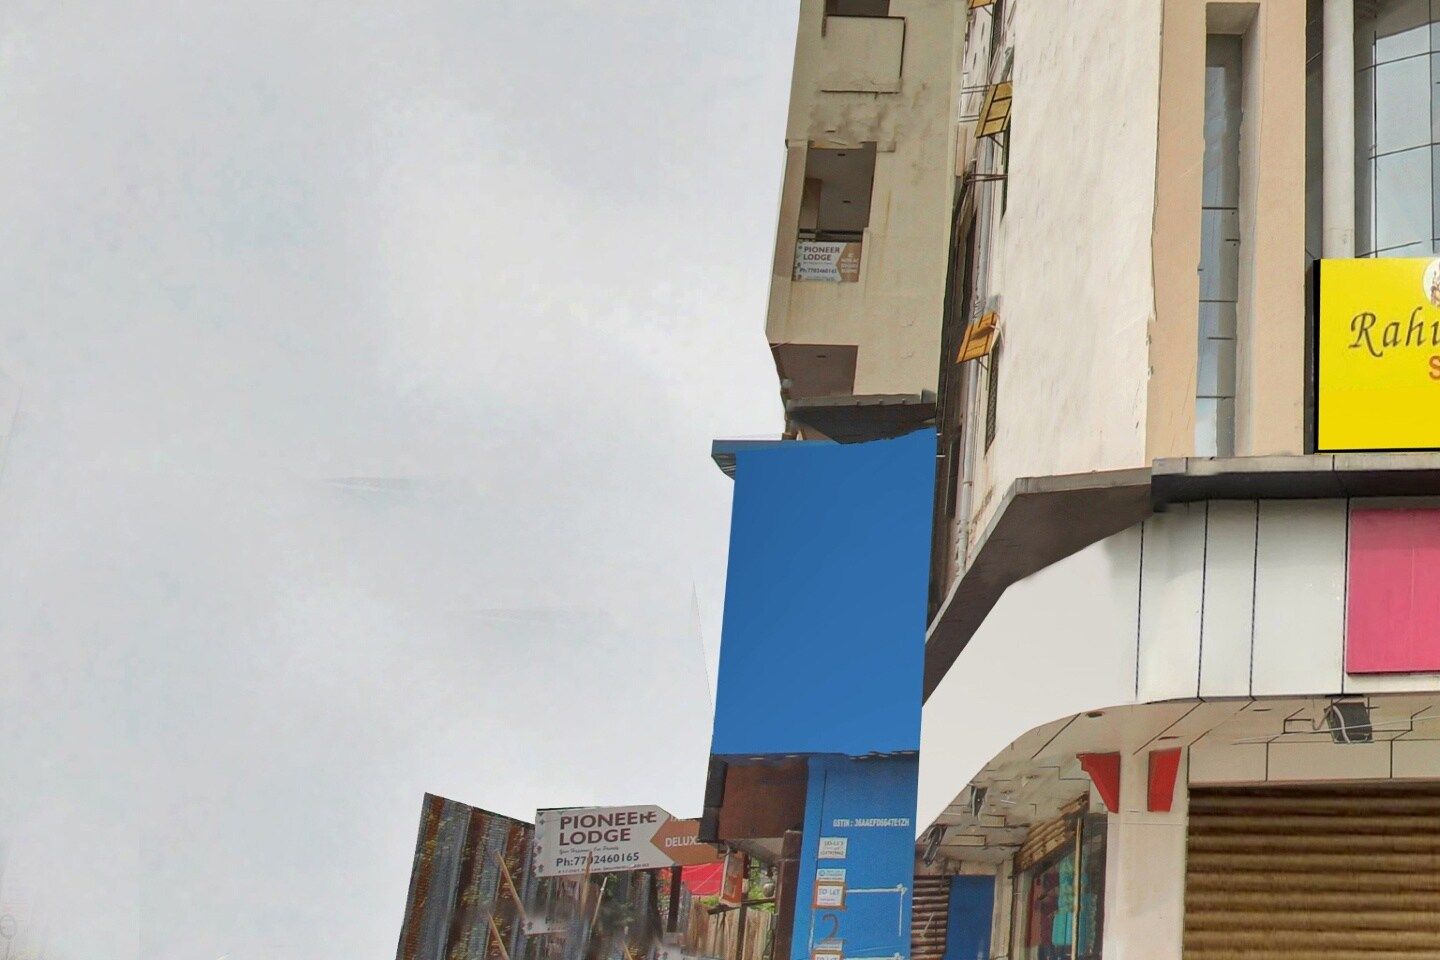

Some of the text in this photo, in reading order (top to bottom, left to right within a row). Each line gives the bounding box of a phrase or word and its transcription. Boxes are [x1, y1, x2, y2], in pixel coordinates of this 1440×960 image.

[803, 245, 840, 253] PIONEER
[803, 253, 832, 261] LODGE
[559, 828, 631, 846] LODGE
[665, 836, 704, 847] DELUX
